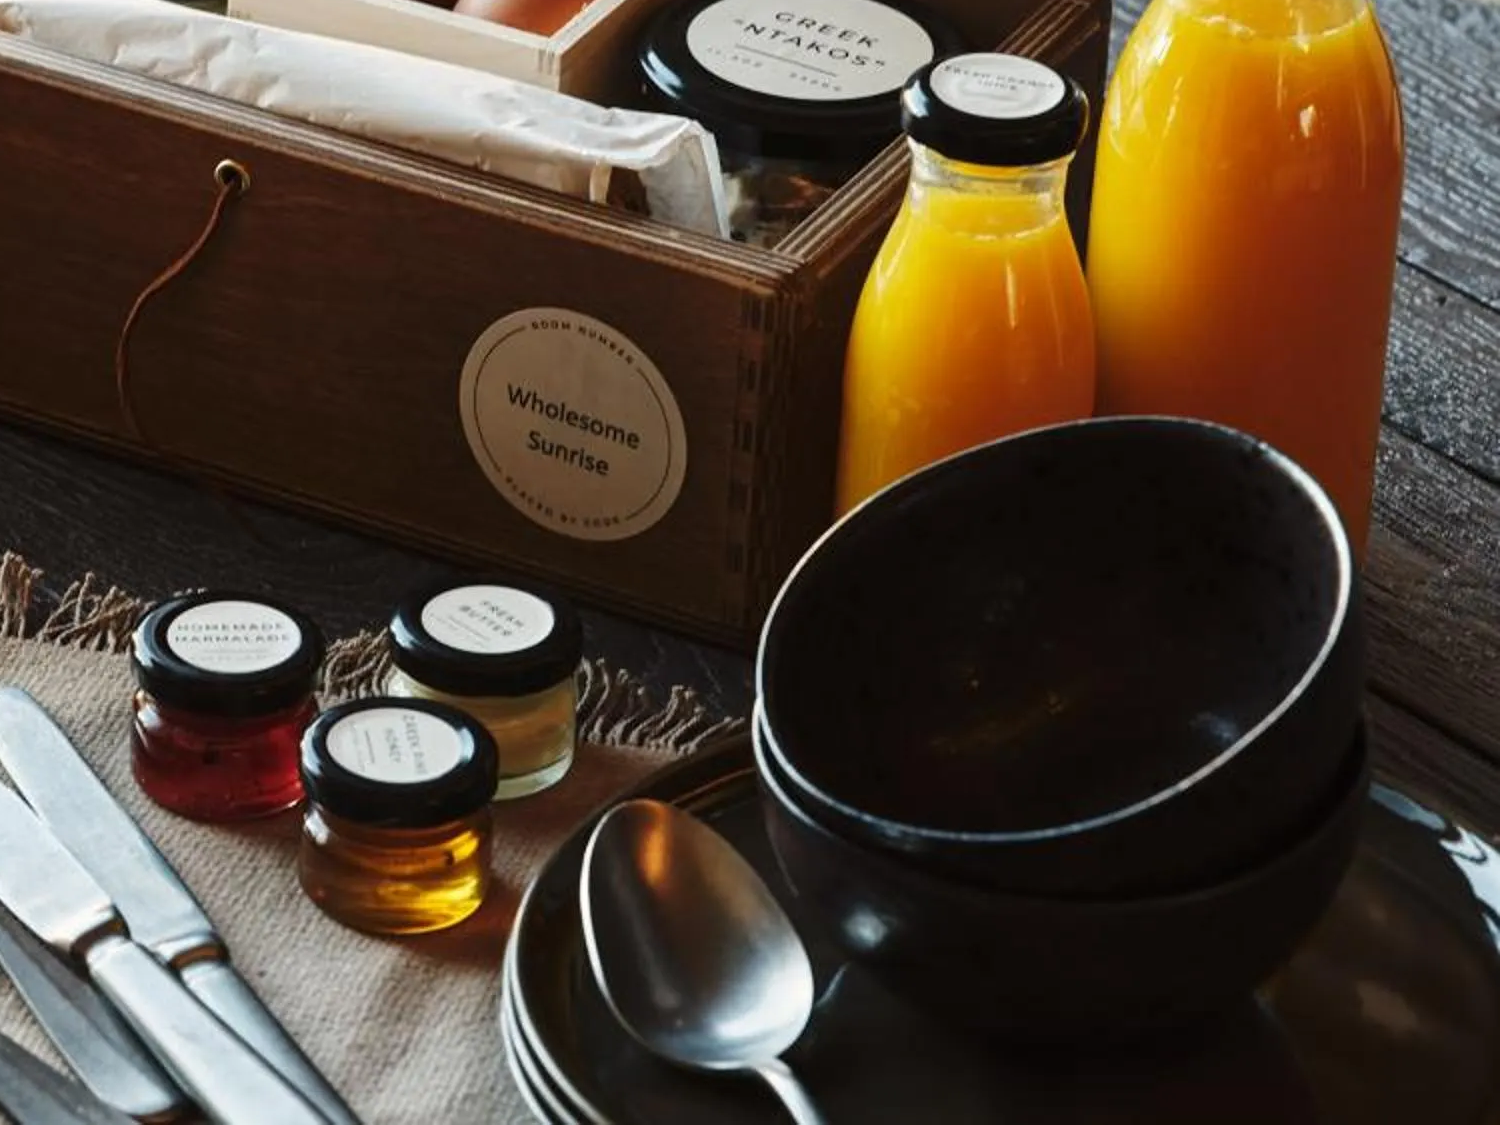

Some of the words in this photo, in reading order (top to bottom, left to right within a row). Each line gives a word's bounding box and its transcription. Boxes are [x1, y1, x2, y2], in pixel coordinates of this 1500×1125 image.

[775, 11, 879, 48] GREEK
[507, 382, 641, 450] Wholesome
[527, 430, 610, 476] Sunrise
[175, 633, 290, 643] MARMALADE
[177, 622, 285, 632] HOMEMADE
